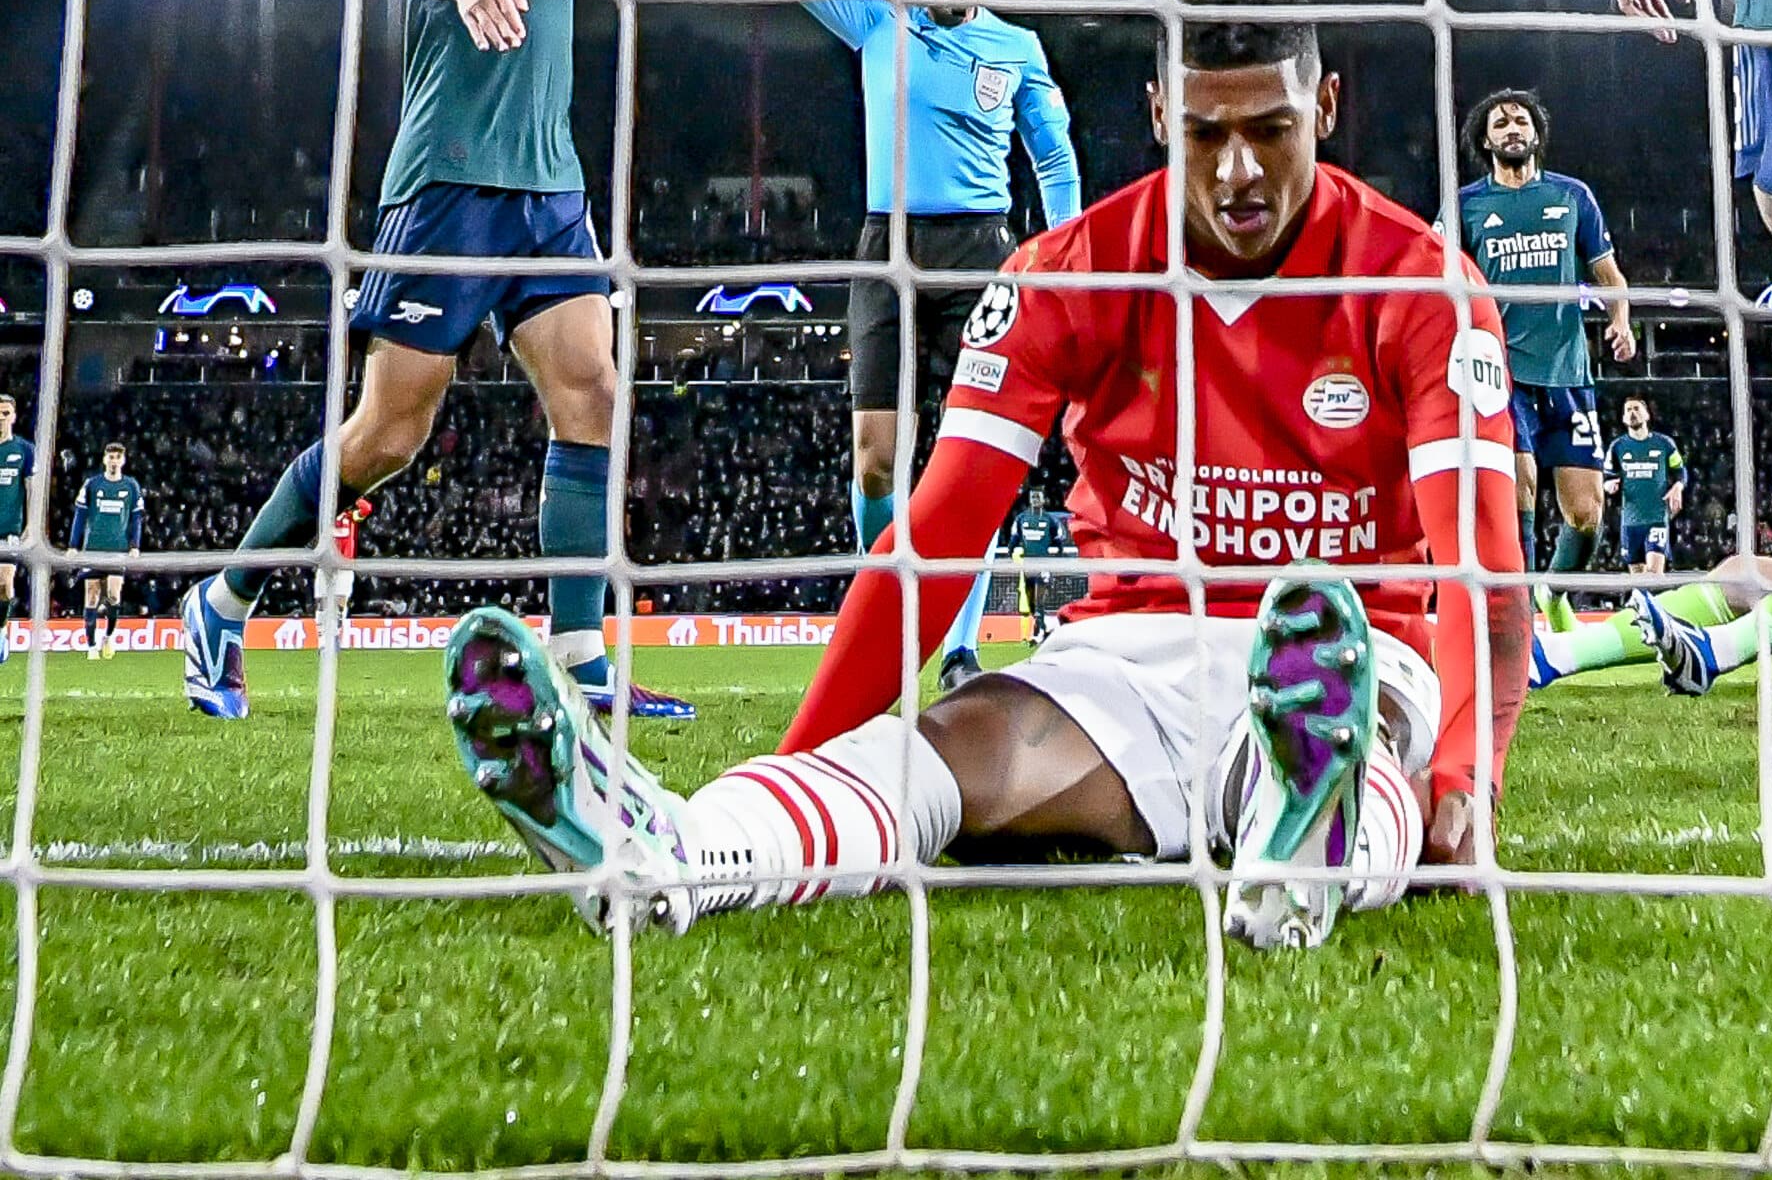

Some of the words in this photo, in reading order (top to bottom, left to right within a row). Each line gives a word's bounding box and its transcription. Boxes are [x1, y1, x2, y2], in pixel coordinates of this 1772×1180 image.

[1486, 231, 1569, 259] Emirates
[1119, 453, 1377, 523] BRINPORT
[1120, 477, 1377, 560] EINDHOVEN
[711, 617, 836, 646] Thuisbe
